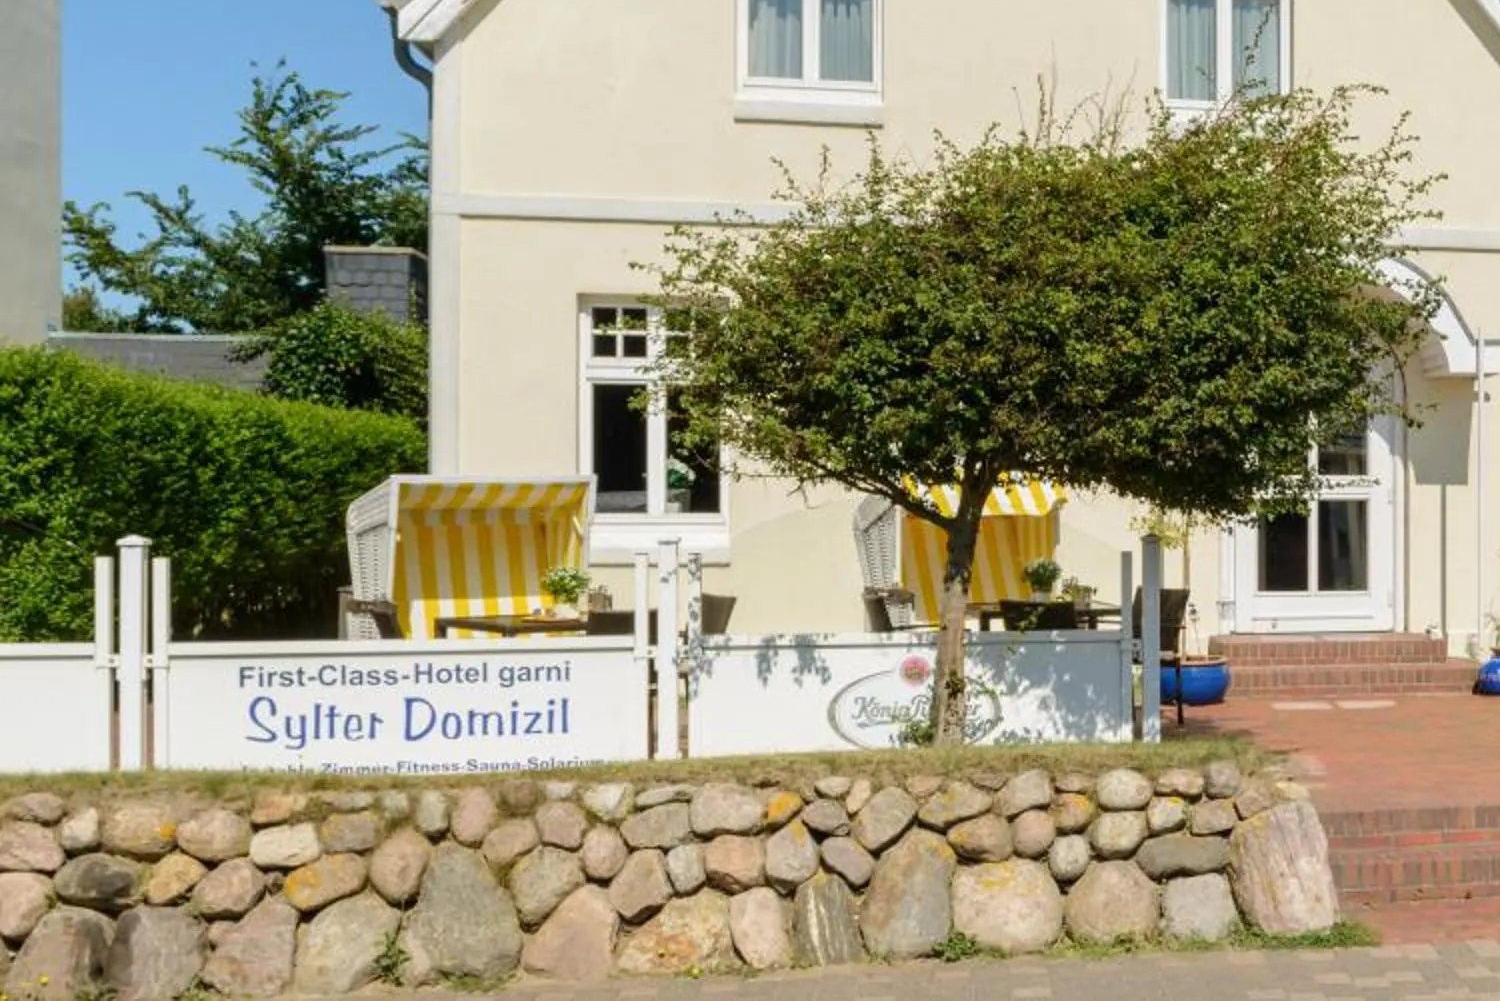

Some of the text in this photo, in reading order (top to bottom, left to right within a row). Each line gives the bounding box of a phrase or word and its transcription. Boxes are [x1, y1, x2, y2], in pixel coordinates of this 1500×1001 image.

[239, 660, 571, 688] First-Class-Hotel garni
[245, 696, 570, 750] Sylter Domizil
